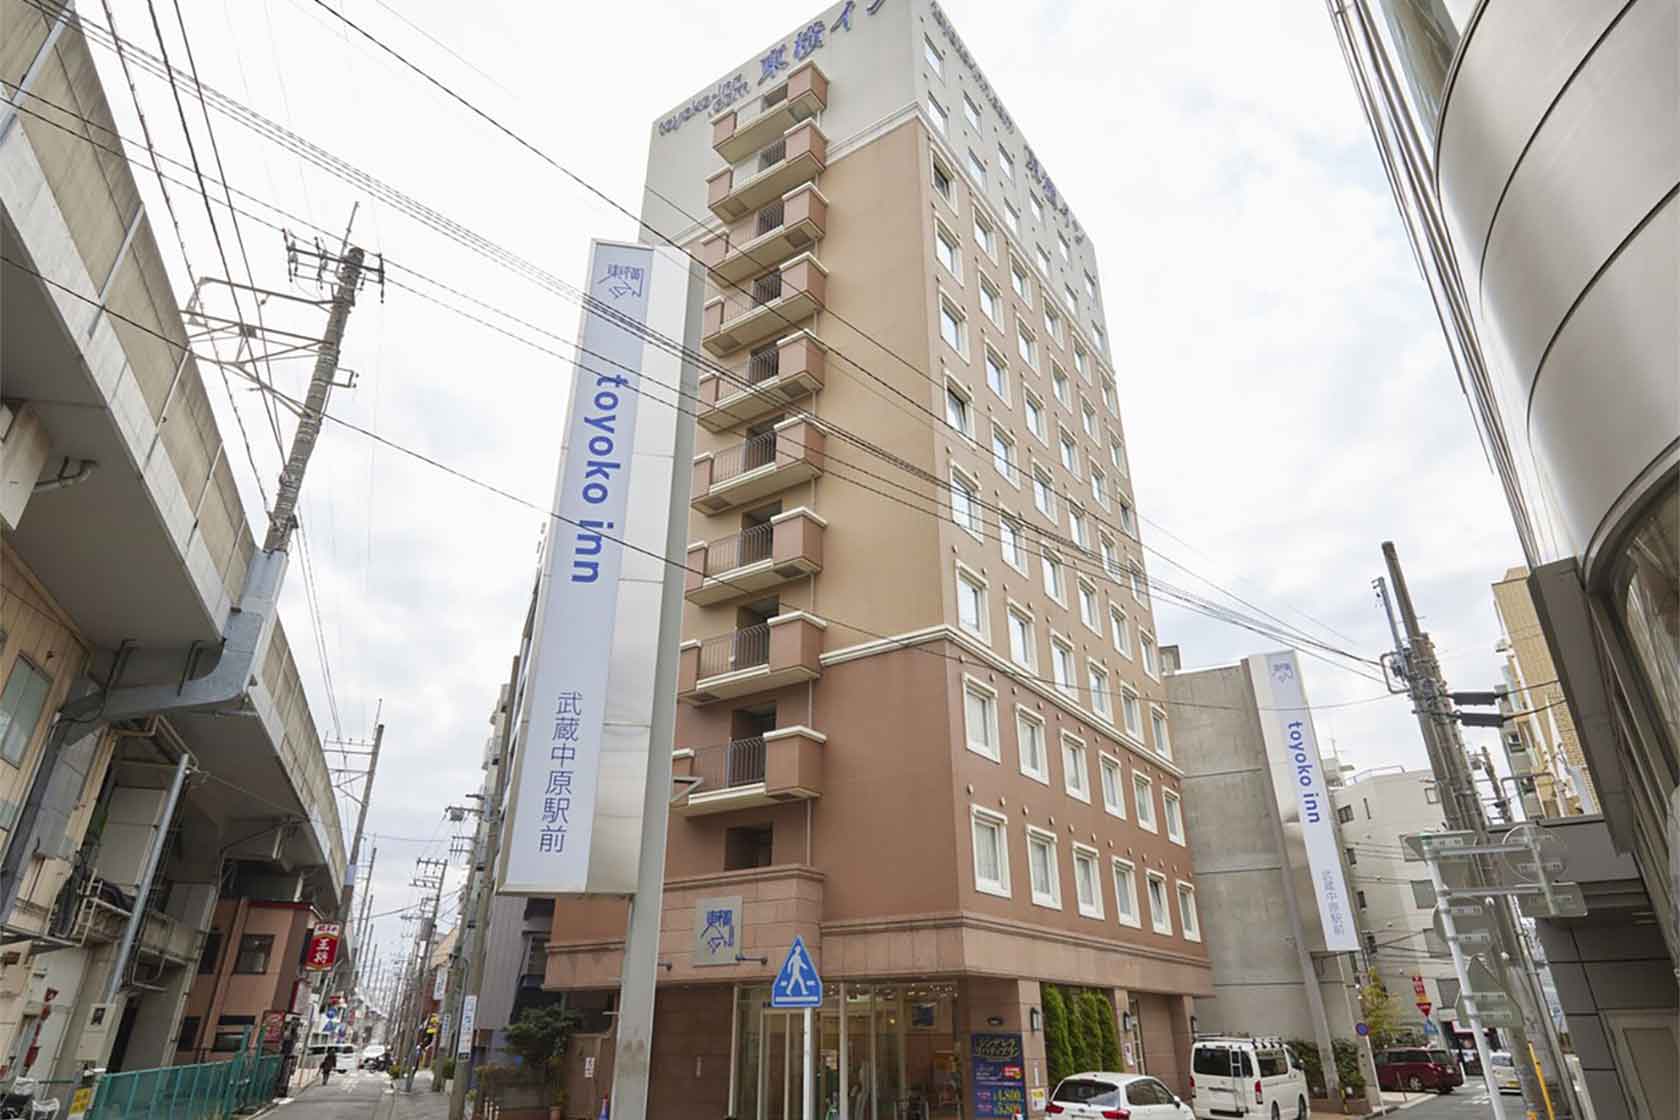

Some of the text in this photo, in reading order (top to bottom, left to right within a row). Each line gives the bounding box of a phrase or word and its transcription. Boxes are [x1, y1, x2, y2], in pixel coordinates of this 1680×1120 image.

[571, 374, 629, 584] toyoko inn
[539, 690, 583, 855] 武蔵中原駅前
[1288, 720, 1320, 824] toyoko inn
